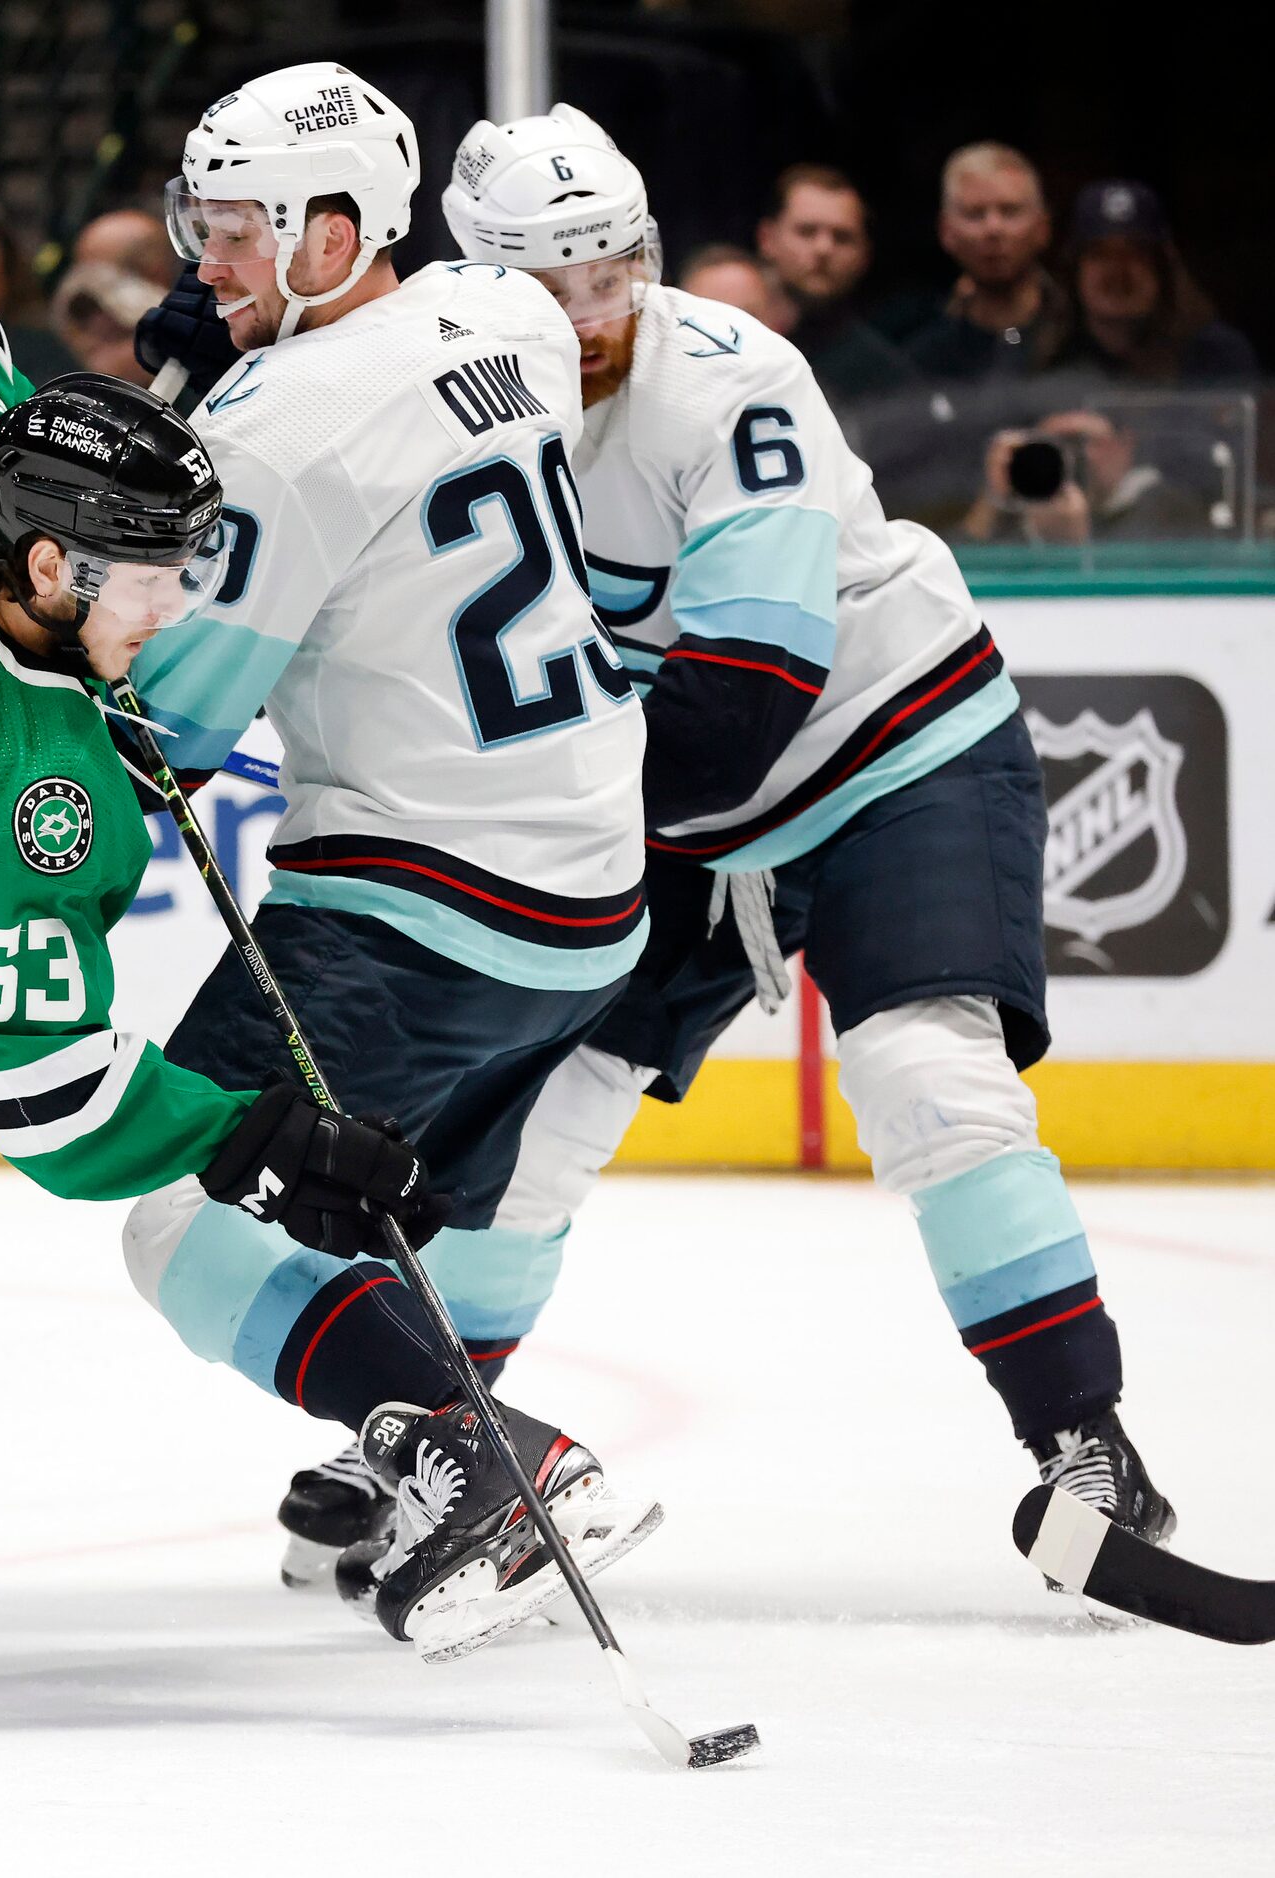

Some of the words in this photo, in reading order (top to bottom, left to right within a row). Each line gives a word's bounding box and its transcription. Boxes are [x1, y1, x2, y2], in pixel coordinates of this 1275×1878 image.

[318, 86, 351, 101] THE
[284, 99, 355, 123] CLIMATE
[295, 112, 358, 135] PLEDGE
[551, 155, 574, 182] 6
[553, 220, 612, 241] BAUER
[441, 328, 474, 342] adidas
[48, 428, 112, 463] TRANSFER
[51, 415, 105, 443] ENERGY
[179, 448, 213, 486] 53
[729, 404, 807, 498] 6
[420, 431, 635, 753] 29
[24, 784, 90, 830] DALLAS
[22, 831, 81, 868] STARS
[242, 943, 274, 995] JOHNSTON
[400, 1157, 420, 1198] CCM
[372, 1416, 406, 1447] 29
